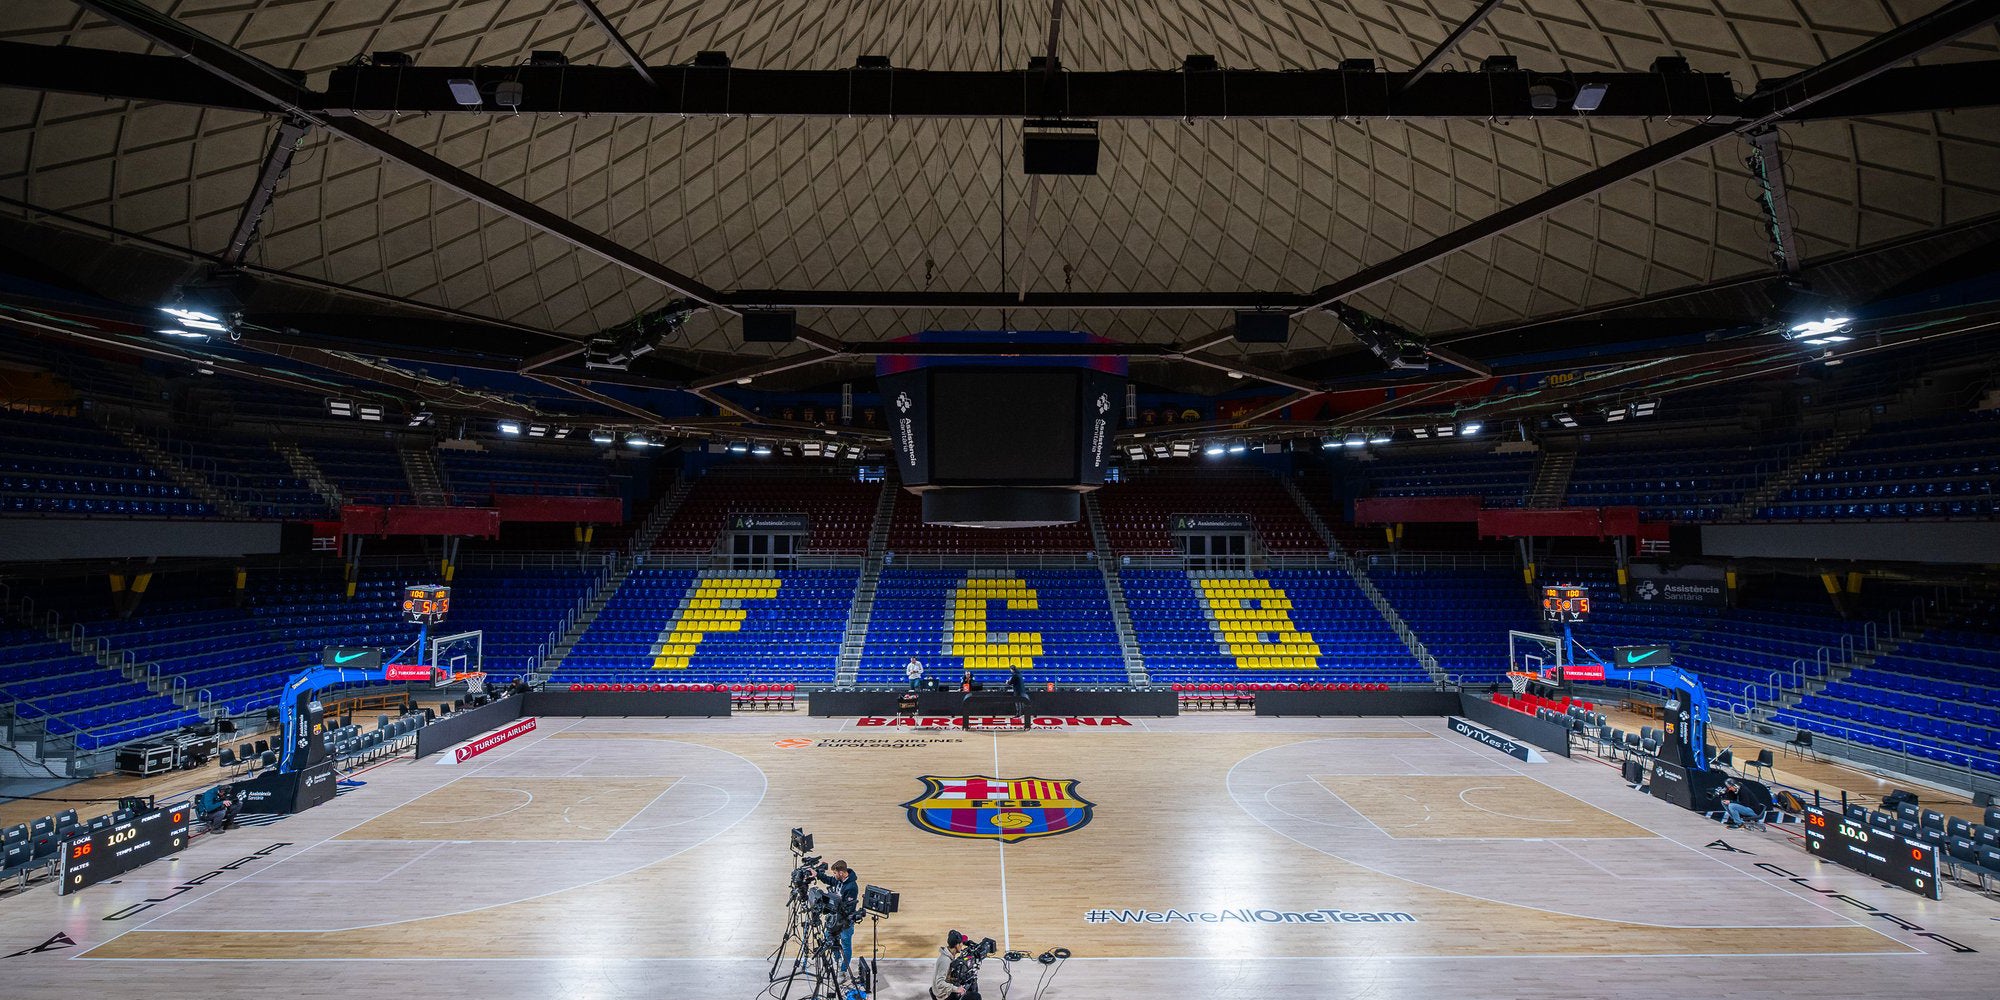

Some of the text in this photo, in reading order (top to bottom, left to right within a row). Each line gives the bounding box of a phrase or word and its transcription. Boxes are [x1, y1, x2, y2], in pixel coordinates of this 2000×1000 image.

[905, 417, 916, 466] Assistència
[1094, 418, 1106, 467] Assistència
[736, 519, 744, 528] A
[1178, 519, 1186, 528] A
[1664, 584, 1719, 594] Assistència
[423, 601, 430, 613] 5
[442, 600, 449, 611] 5
[1580, 600, 1588, 611] 5
[652, 579, 1321, 669] F C B
[856, 717, 1133, 727] BARCELONA
[474, 720, 535, 752] TURKISH AIRLINES
[1456, 723, 1501, 748] OlyTV.es
[972, 800, 1042, 808] FCB
[173, 812, 181, 823] 0
[1809, 813, 1825, 827] 36
[115, 823, 131, 831] TEMPS
[107, 828, 136, 846] 10.0
[1839, 824, 1868, 843] 10.0
[73, 836, 91, 845] LOCAL
[173, 838, 180, 846] 0
[1812, 841, 1820, 850] 0
[72, 843, 92, 858] 36
[1912, 849, 1922, 861] 0
[70, 862, 89, 872] FALTES
[74, 874, 82, 884] 0
[102, 843, 294, 921] CUPRA
[1916, 878, 1924, 888] 0
[1753, 863, 1979, 953] CUPRA
[1085, 909, 1416, 923] #WeAreAllOneTeam
